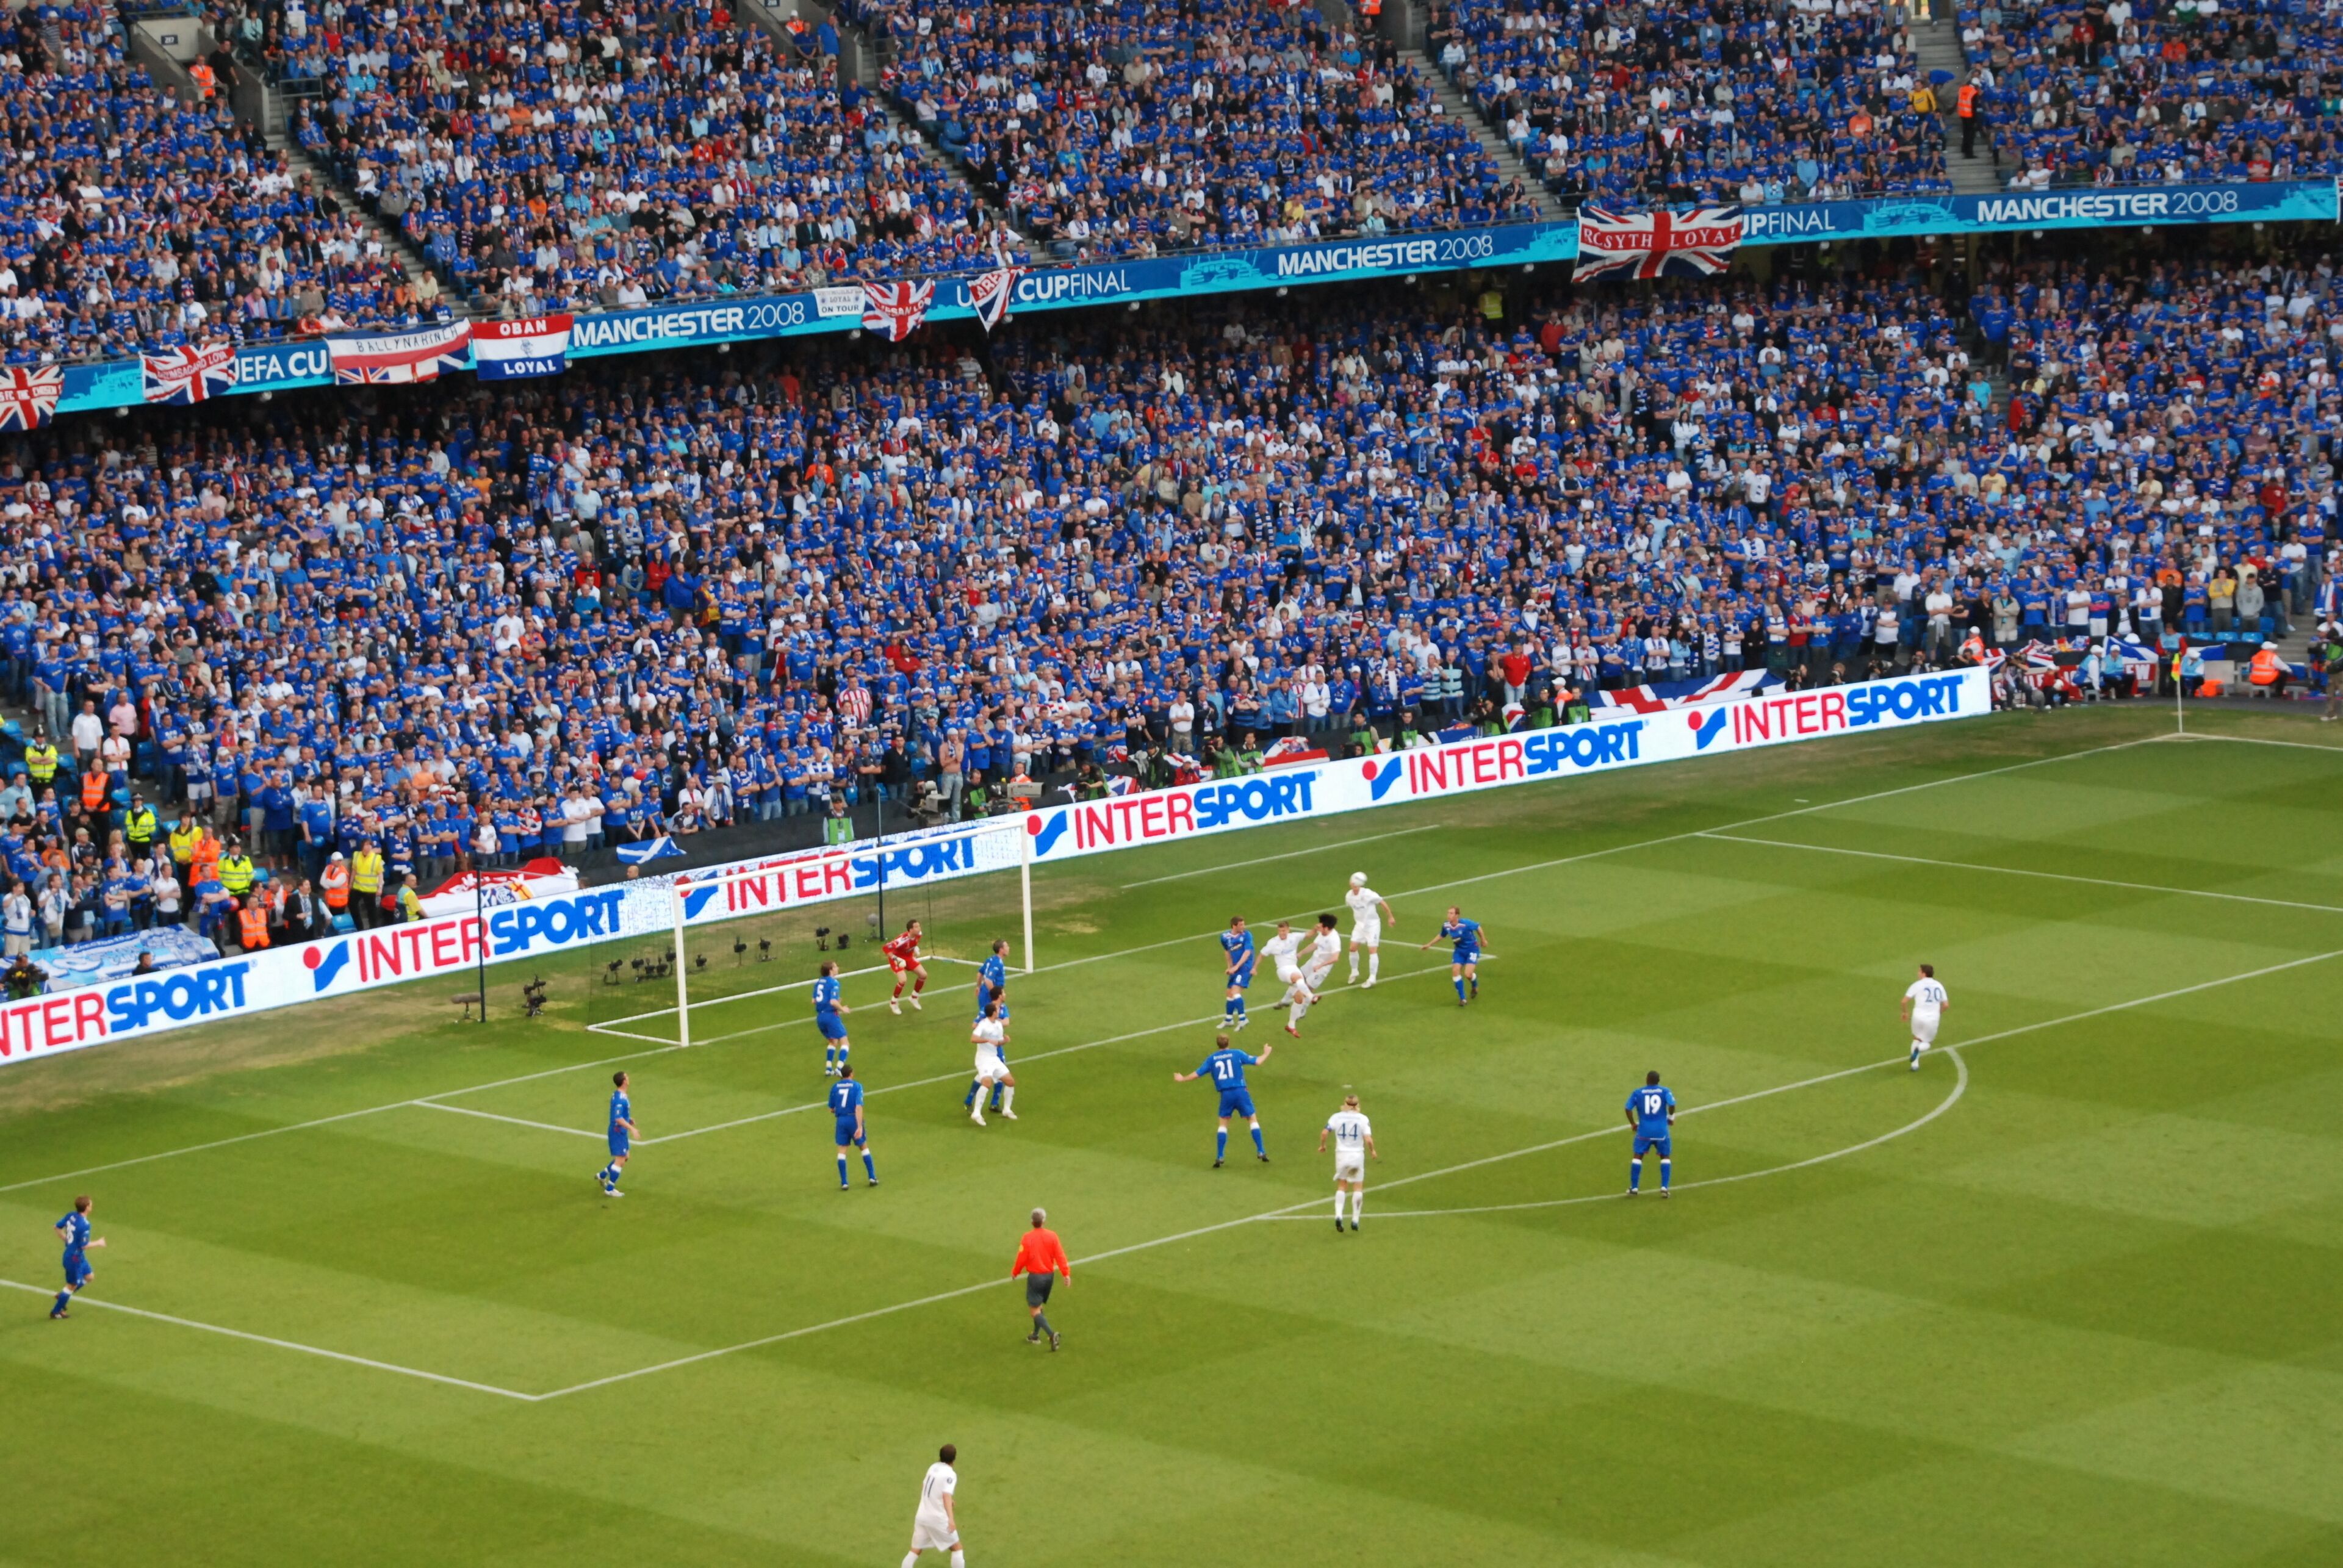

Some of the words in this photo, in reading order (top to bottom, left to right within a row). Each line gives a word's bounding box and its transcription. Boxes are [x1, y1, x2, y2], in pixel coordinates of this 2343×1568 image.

[1978, 193, 2168, 222] MANCHESTER
[2172, 190, 2238, 215] 2008
[1278, 240, 1436, 276] MANCHESTER
[1440, 235, 1493, 261] 2008
[500, 320, 547, 336] OBAN
[574, 307, 744, 347] MANCHESTER
[747, 301, 805, 329] 2008
[503, 360, 556, 375] LOYAL
[1734, 675, 1963, 744] INTERSPORT
[1409, 720, 1643, 794] INTERSPORT
[1075, 771, 1317, 849] INTERSPORT
[726, 827, 979, 911] INTERSPORT
[358, 890, 625, 982] INTERSPORT
[816, 984, 824, 1002] 5
[1923, 987, 1942, 1003] 20
[1215, 1059, 1234, 1080] 21
[838, 1088, 849, 1107] 7
[1644, 1095, 1661, 1115] 19
[1337, 1123, 1359, 1141] 44
[924, 1475, 935, 1498] 11
